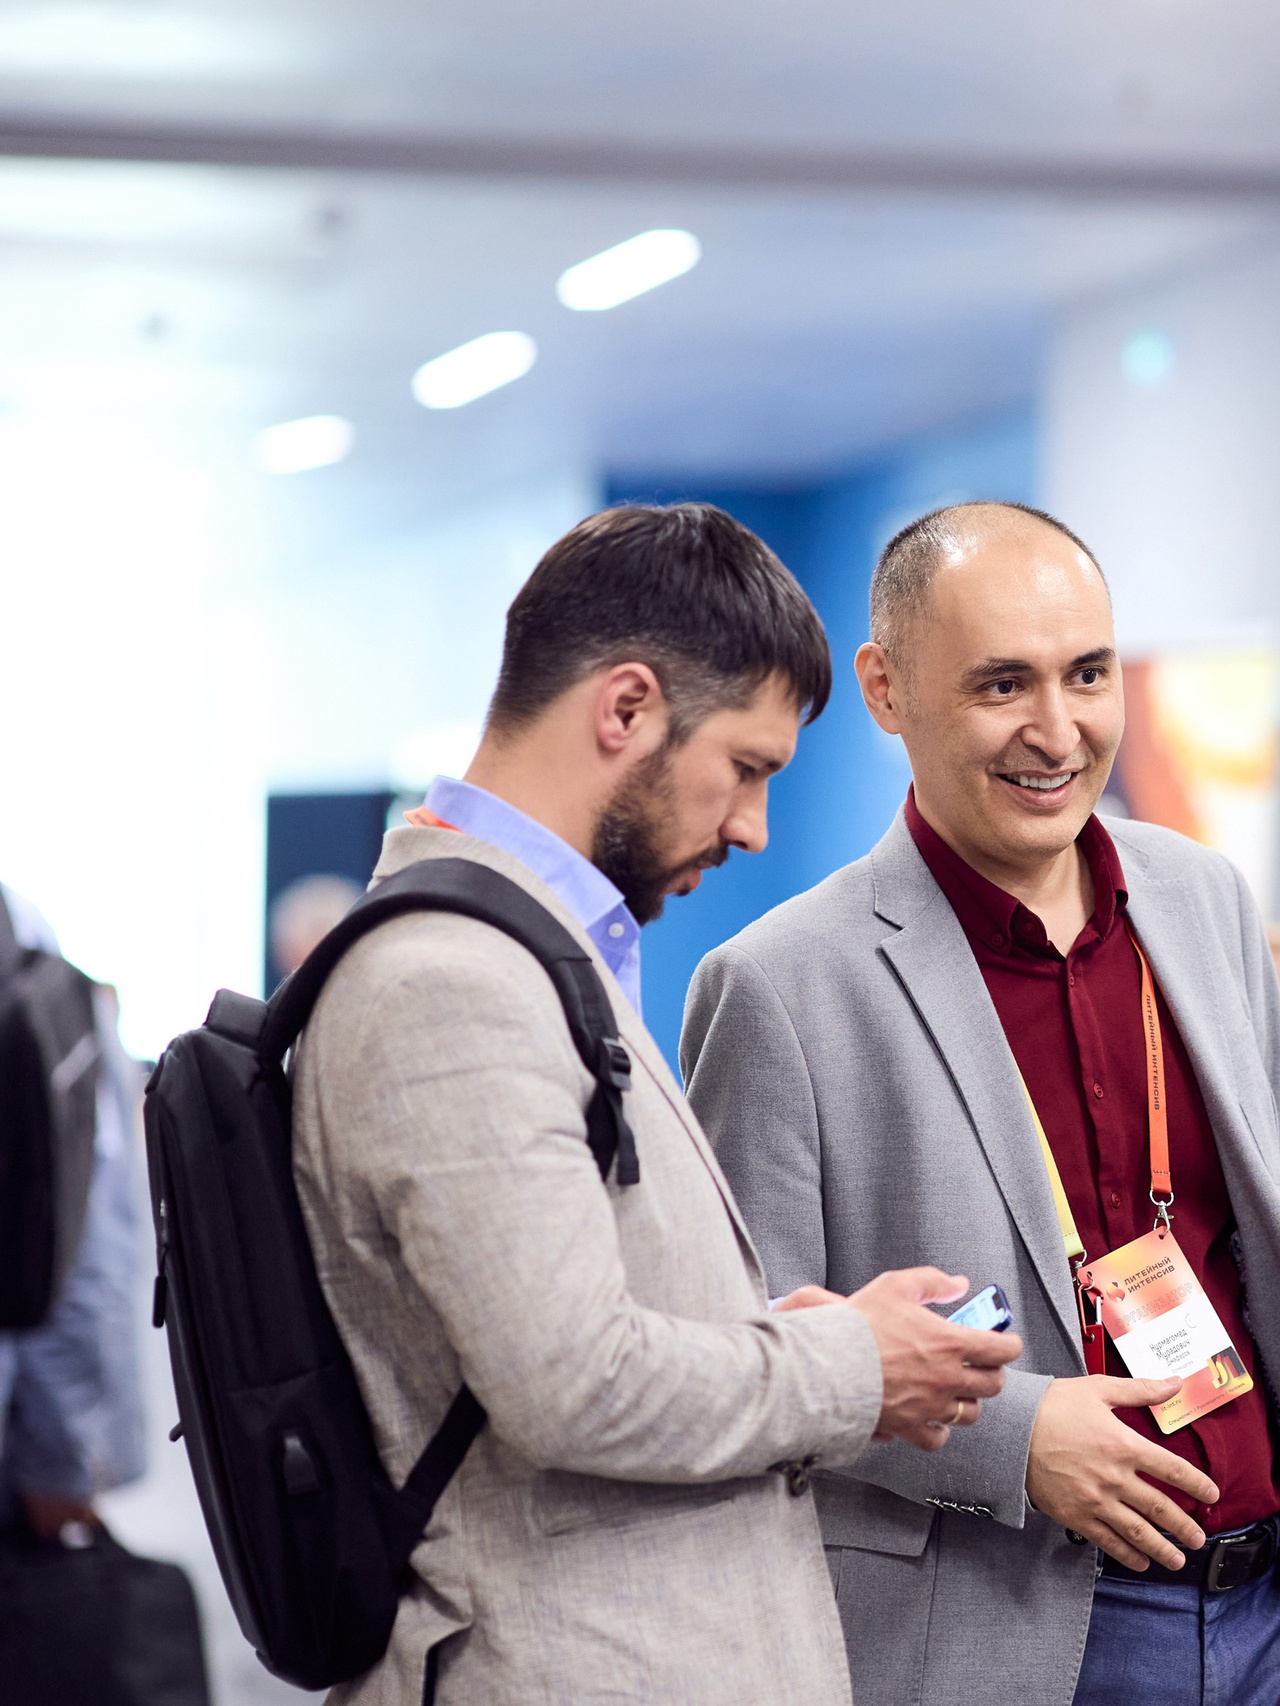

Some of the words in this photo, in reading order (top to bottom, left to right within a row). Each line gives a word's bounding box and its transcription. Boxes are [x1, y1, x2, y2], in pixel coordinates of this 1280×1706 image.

[1146, 994, 1158, 1051] ЛИТЕЙНЫЙ
[1152, 1054, 1160, 1110] ИНТЕНСИВ
[1124, 1256, 1171, 1286] ЛИТЕЙНЫЙ
[1127, 1265, 1175, 1293] ИНТЕНСИВ
[1114, 1282, 1193, 1330] ОРГАНИЗАТОР
[1149, 1329, 1187, 1353] Нурмагомед
[1156, 1339, 1190, 1361] Мурадович
